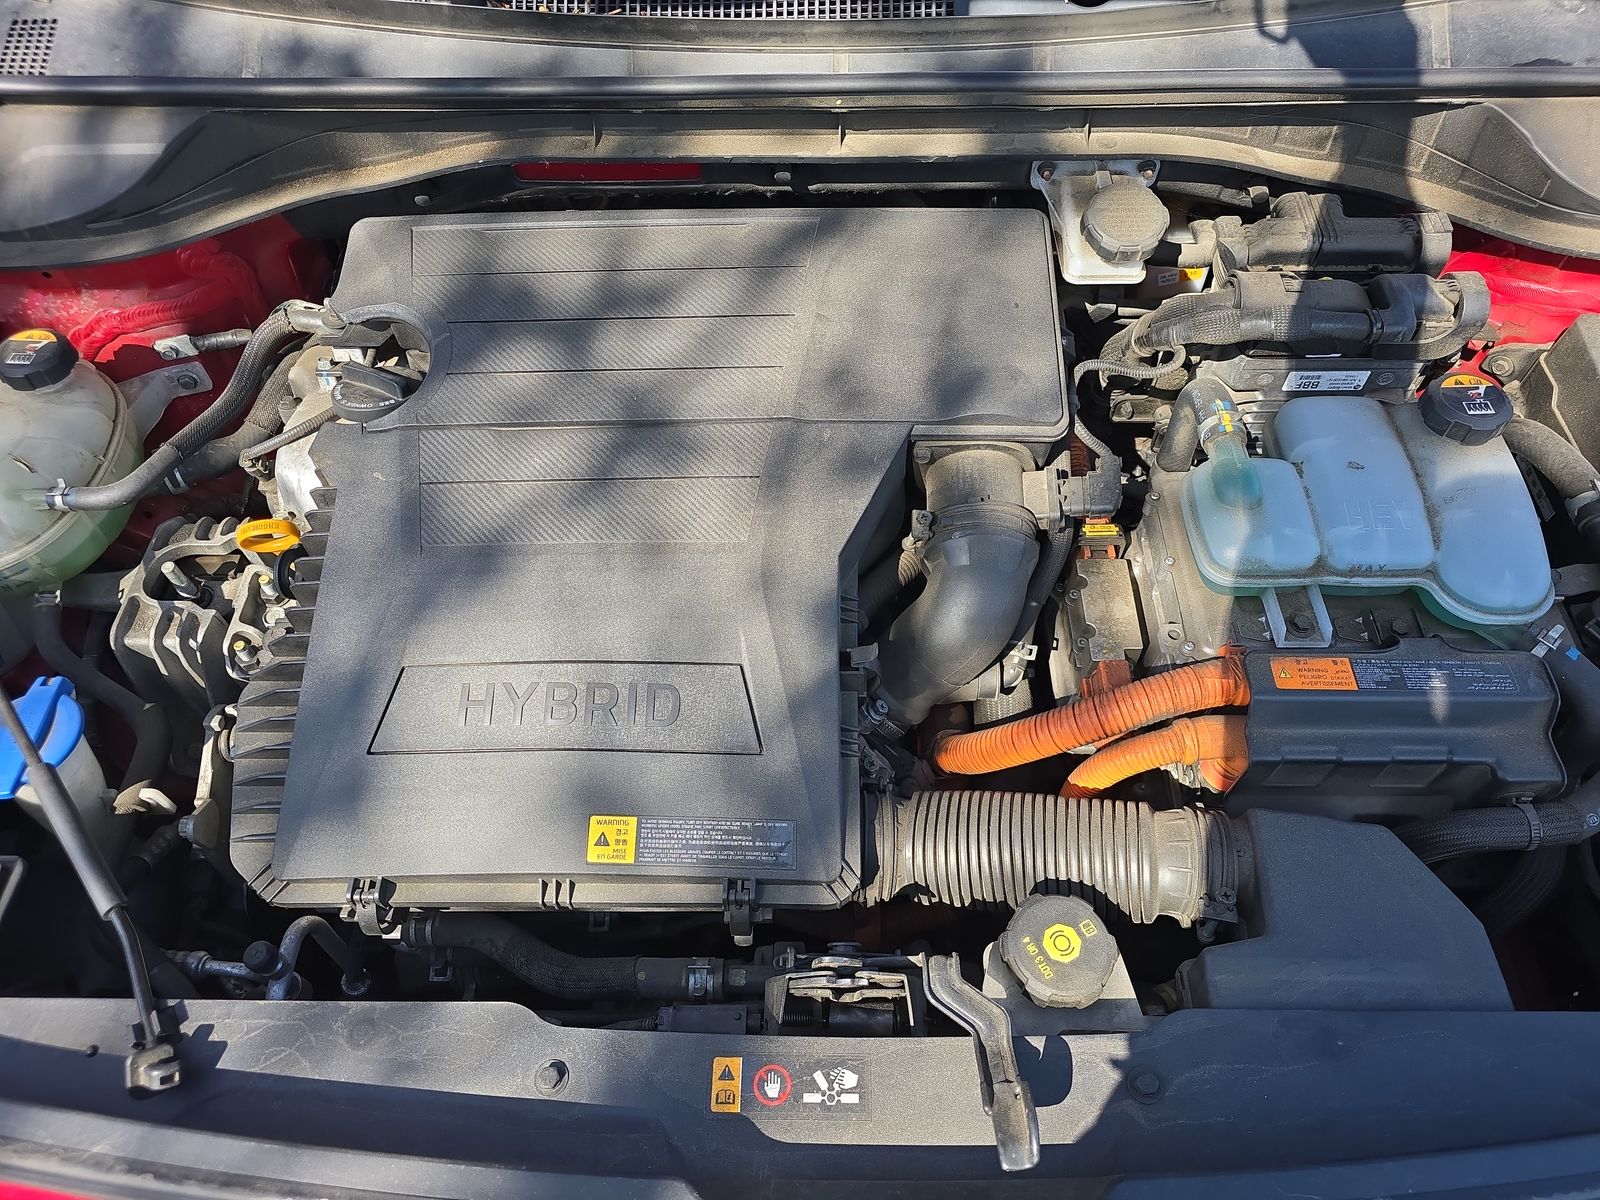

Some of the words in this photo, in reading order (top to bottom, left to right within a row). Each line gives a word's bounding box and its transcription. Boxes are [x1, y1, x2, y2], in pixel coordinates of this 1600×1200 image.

[1294, 381, 1320, 389] BBF
[251, 522, 280, 531] ENGINE
[457, 682, 681, 727] HYBRID
[1026, 943, 1038, 955] OR
[1035, 956, 1053, 979] DOT3
